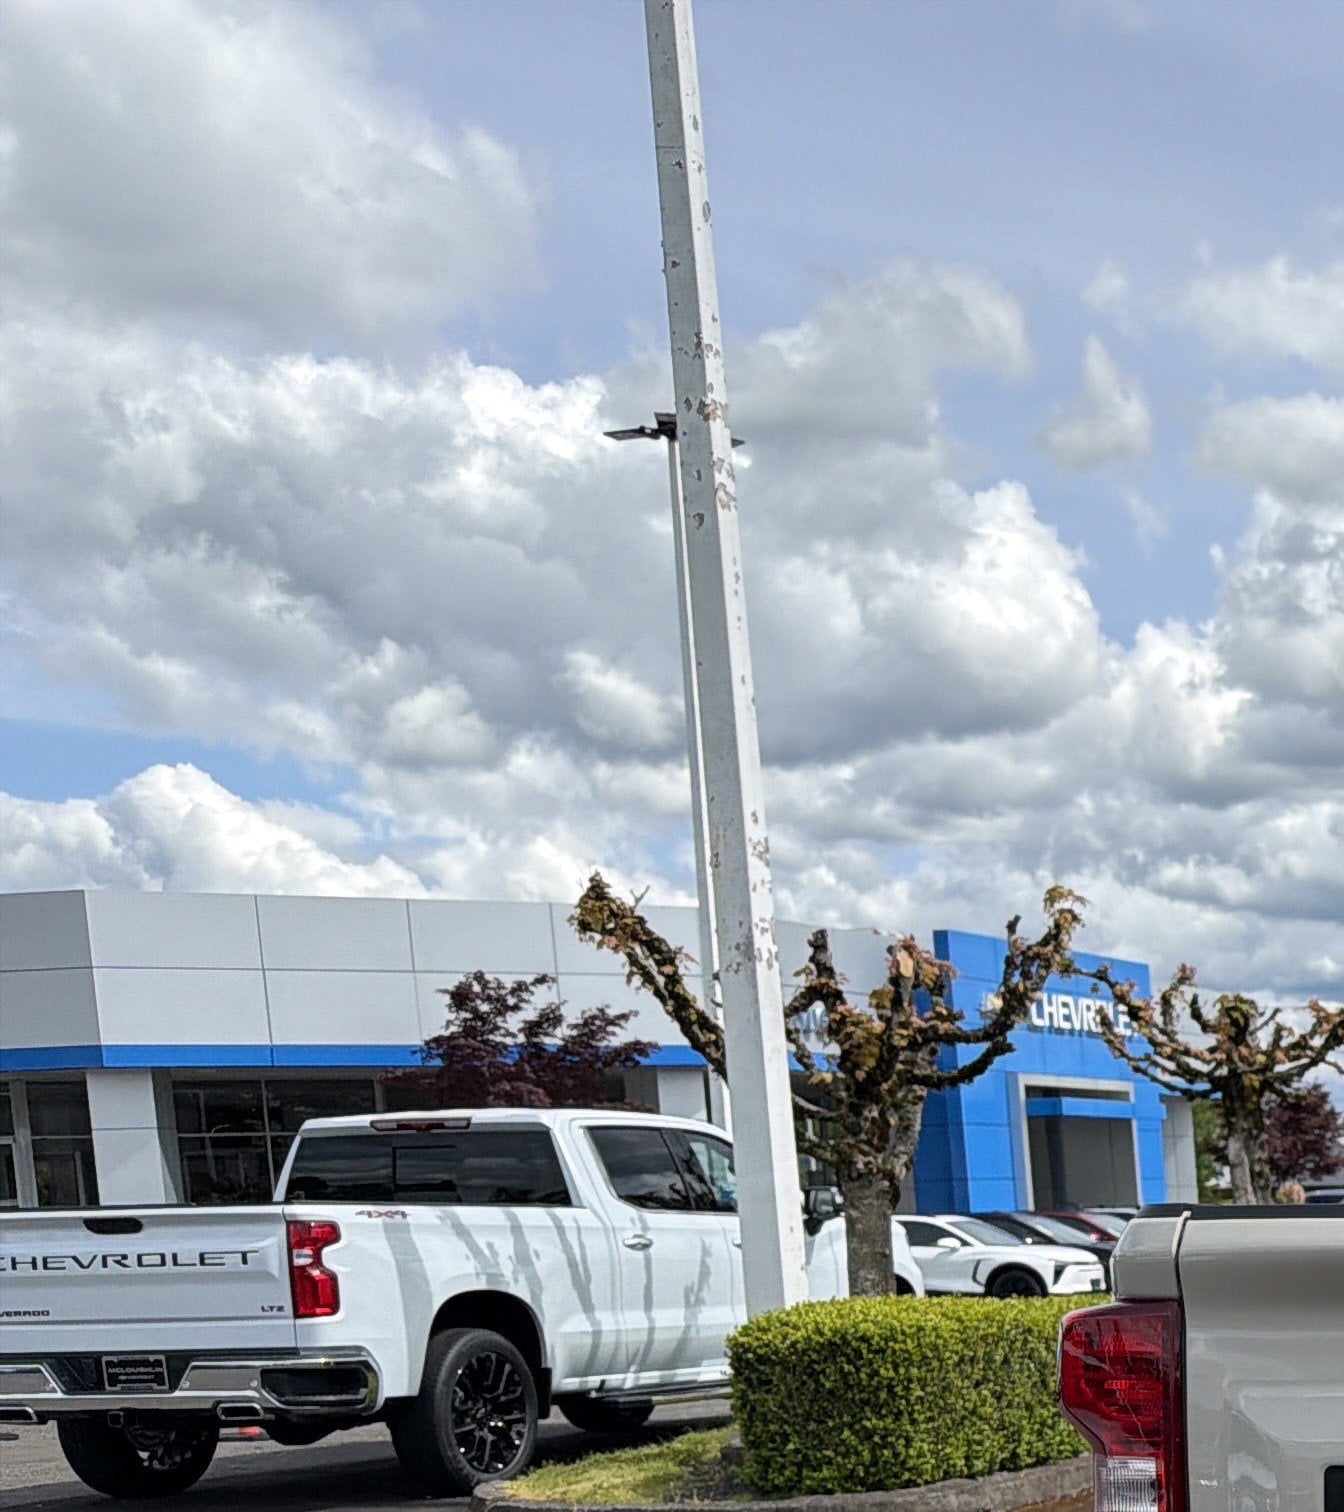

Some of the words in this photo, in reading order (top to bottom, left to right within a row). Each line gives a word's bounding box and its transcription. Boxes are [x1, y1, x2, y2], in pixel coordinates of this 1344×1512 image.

[1030, 993, 1139, 1037] CHEVRLE
[0, 1250, 259, 1271] HEVROLET
[260, 1305, 285, 1313] LTZ
